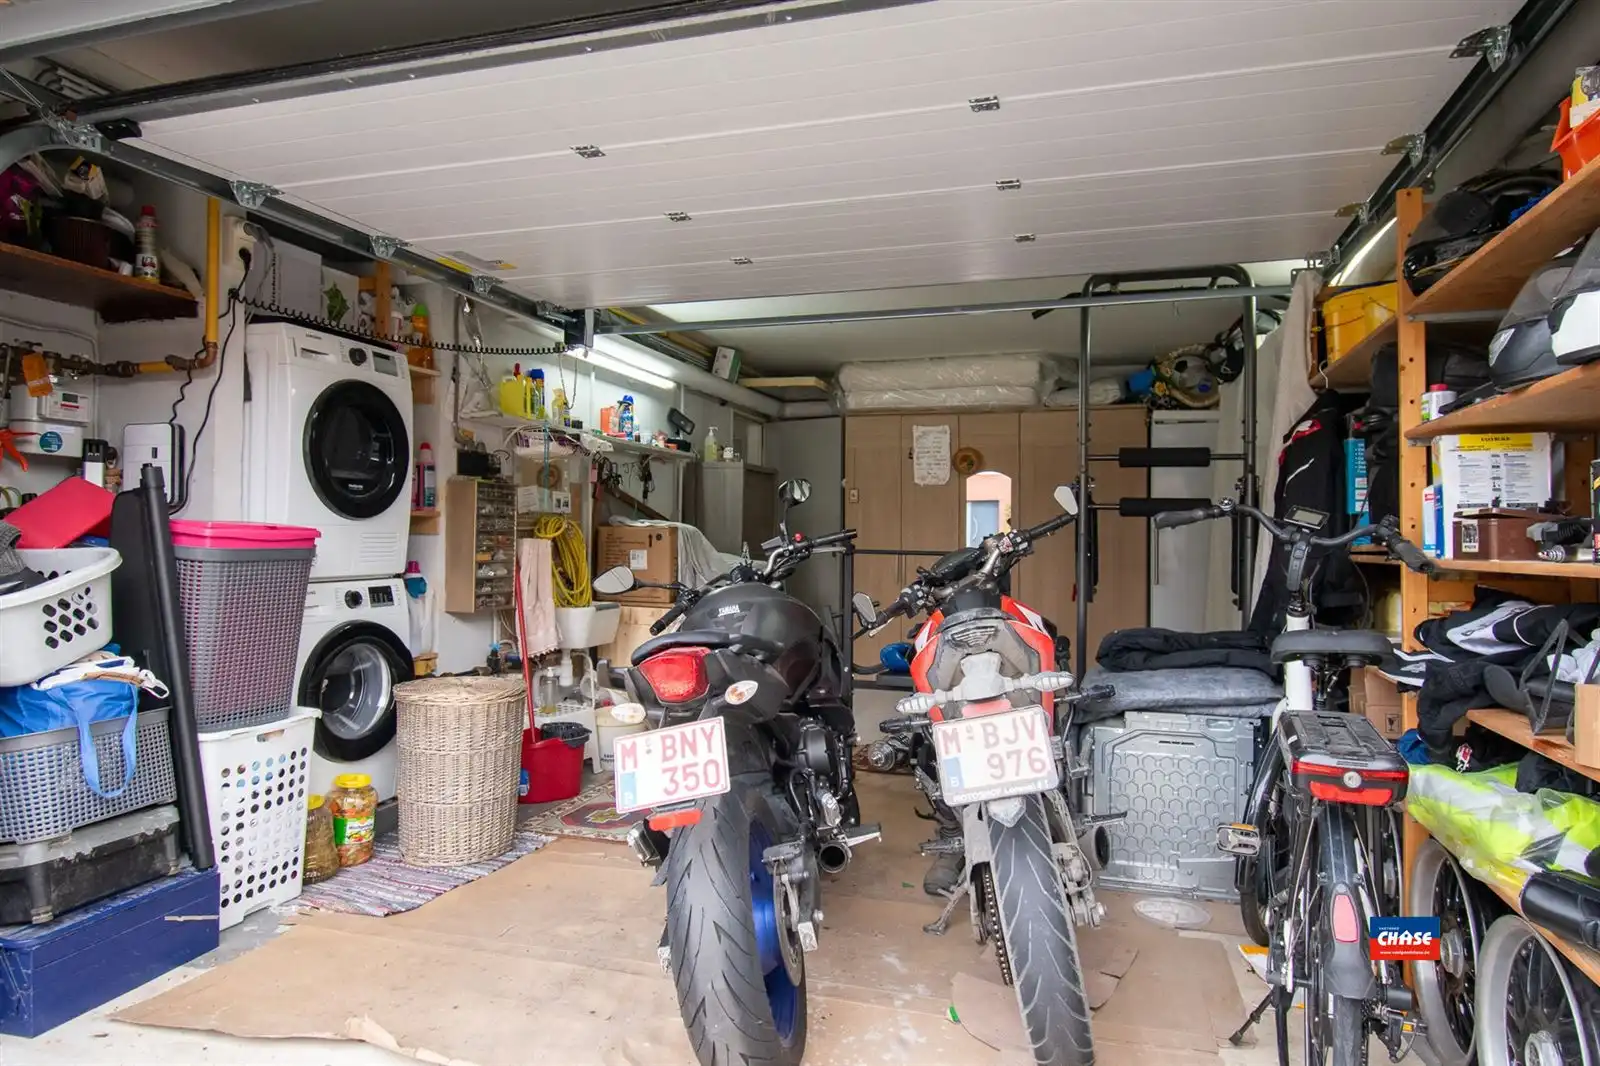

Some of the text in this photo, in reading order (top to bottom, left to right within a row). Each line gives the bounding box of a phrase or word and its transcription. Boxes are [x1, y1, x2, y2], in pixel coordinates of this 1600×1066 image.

[621, 725, 716, 771] M BNY
[941, 714, 1035, 755] M BJV
[661, 758, 721, 796] 350
[986, 746, 1047, 780] 976
